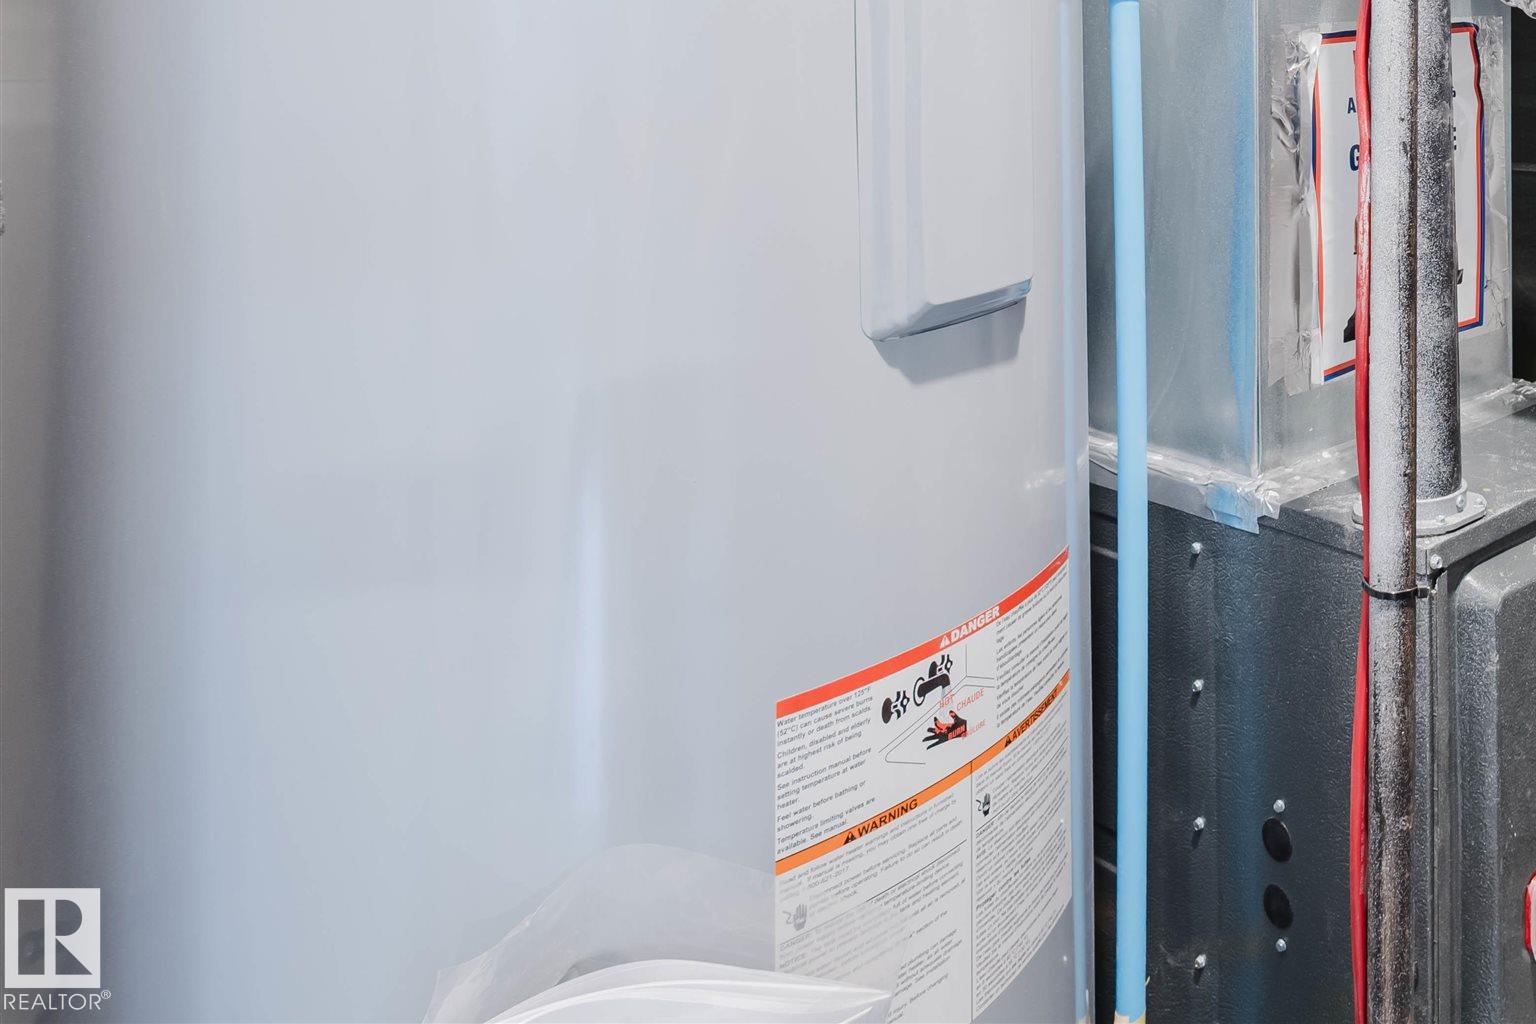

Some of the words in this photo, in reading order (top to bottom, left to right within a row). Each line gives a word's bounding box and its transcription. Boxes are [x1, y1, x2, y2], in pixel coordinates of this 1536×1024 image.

[950, 605, 1000, 643] DANGER
[777, 717, 797, 728] Water
[799, 701, 837, 720] temperature
[838, 695, 853, 705] over
[800, 720, 812, 729] can
[813, 712, 833, 724] cause
[834, 704, 854, 715] severe
[855, 696, 873, 707] burns
[956, 687, 986, 712] CHAUDE
[777, 732, 806, 747] instantly
[815, 718, 835, 732] death
[835, 713, 851, 725] from
[777, 742, 808, 759] Children,
[808, 733, 837, 748] disabled
[838, 726, 850, 737] and
[850, 718, 871, 731] elderly
[777, 761, 788, 769] are
[789, 756, 797, 765] at
[798, 747, 823, 762] highest
[823, 741, 835, 751] risk
[837, 737, 844, 746] of
[844, 730, 862, 743] being
[777, 781, 790, 791] See
[791, 766, 827, 785] instruction
[828, 756, 851, 770] manual
[852, 748, 871, 759] before
[777, 763, 804, 779] scalded.
[777, 787, 800, 801] setting
[801, 770, 841, 791] temperature
[842, 766, 848, 774] at
[849, 759, 866, 770] water
[777, 812, 792, 822] Feel
[793, 804, 812, 816] water
[812, 794, 834, 808] before
[834, 786, 858, 799] bathing
[777, 823, 819, 845] Temperature
[819, 811, 844, 827] limiting
[845, 803, 864, 815] valves
[865, 796, 876, 806] are
[858, 798, 918, 838] WARNING
[809, 831, 823, 841] See
